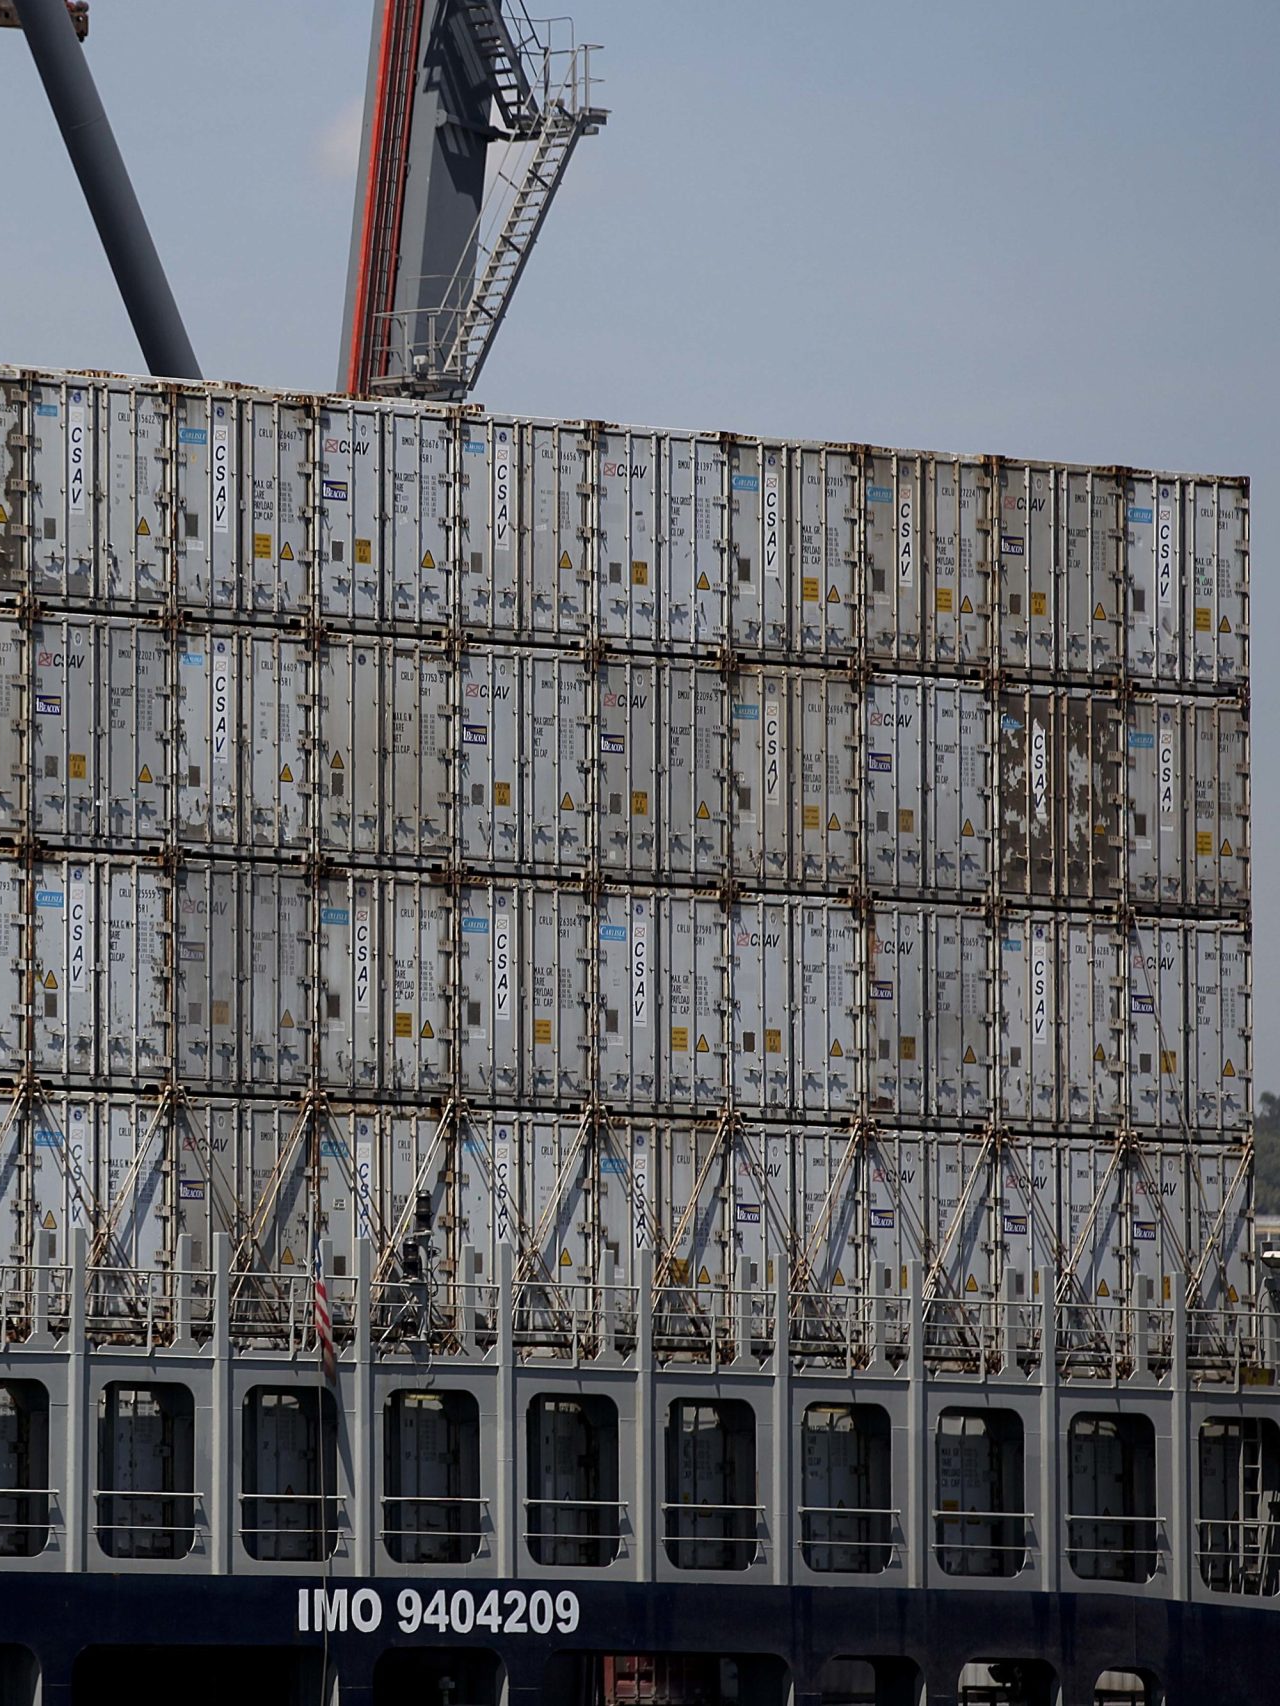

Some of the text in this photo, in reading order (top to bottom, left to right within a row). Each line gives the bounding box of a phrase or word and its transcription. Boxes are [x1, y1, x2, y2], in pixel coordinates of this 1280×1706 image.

[71, 427, 82, 504] CSAV
[215, 445, 227, 522] CSAV
[497, 465, 508, 540] CSAV
[767, 492, 777, 567] CSAV
[900, 503, 911, 577] CSAV
[1160, 525, 1170, 599] CSAV
[216, 677, 227, 753] CSAV
[767, 721, 778, 794] CSAV
[1034, 735, 1045, 808] CSAV
[72, 904, 83, 982] CSAV
[356, 926, 368, 1002] CSAV
[497, 934, 508, 1010] CSAV
[634, 942, 645, 1017] CSAV
[1034, 960, 1044, 1034] CSAV
[298, 1588, 580, 1633] IMO 9404209
